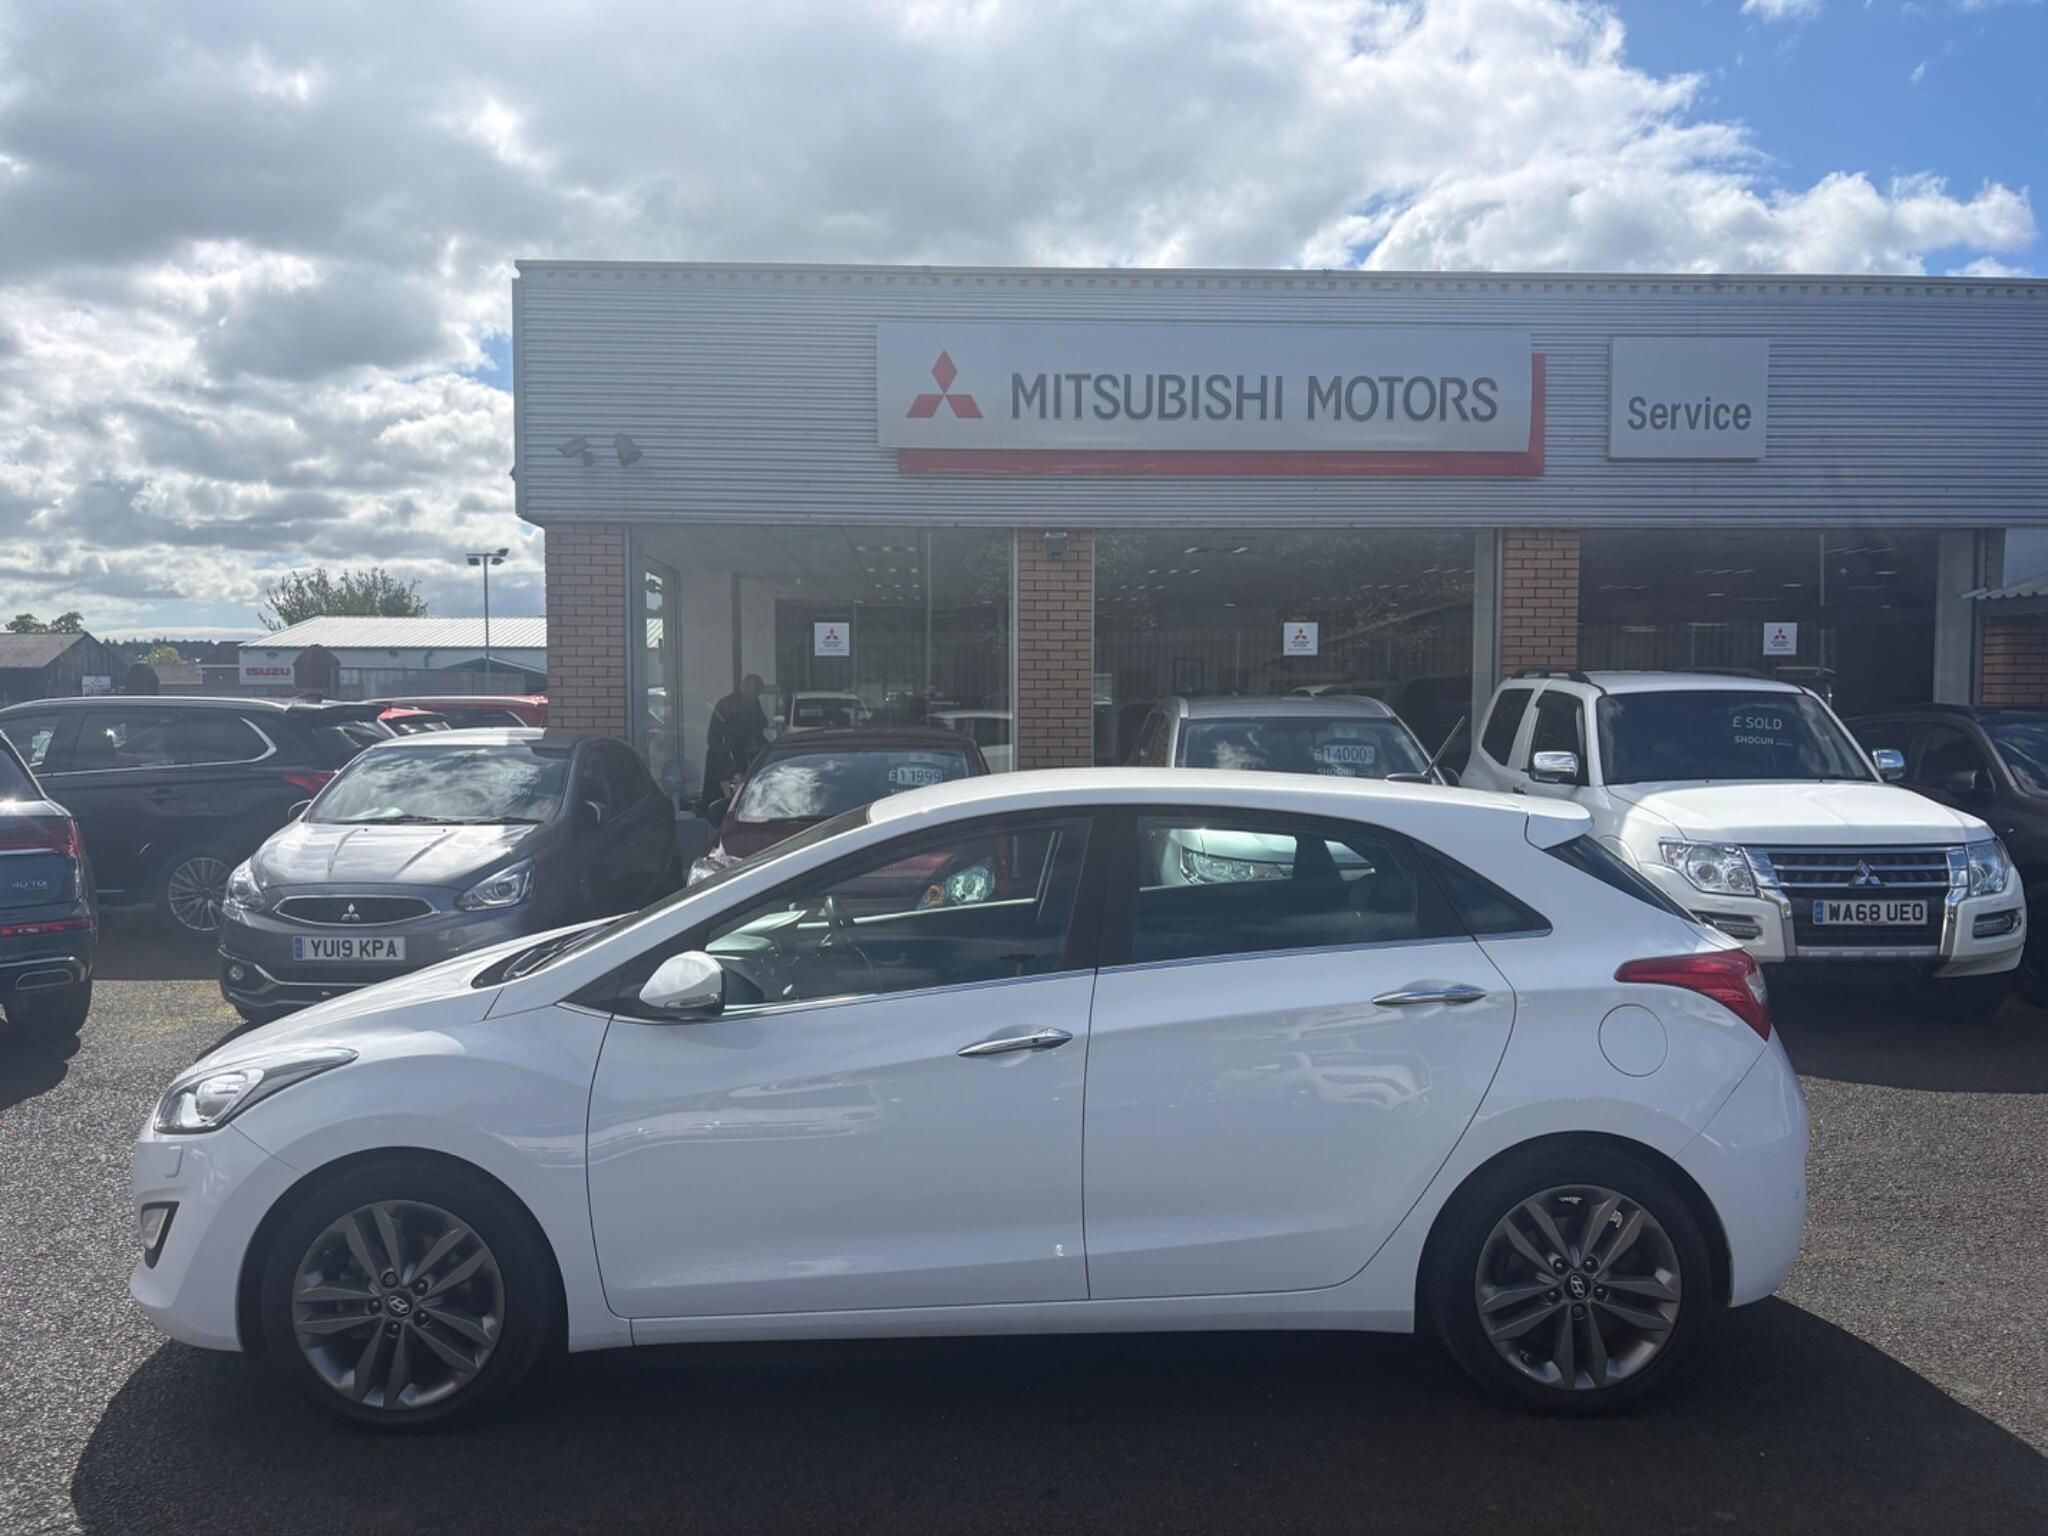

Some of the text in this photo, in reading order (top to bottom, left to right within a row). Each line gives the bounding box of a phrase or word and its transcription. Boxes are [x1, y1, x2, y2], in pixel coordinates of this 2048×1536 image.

[1011, 373, 1498, 422] MITSUBISHI MOTORS
[1627, 396, 1752, 431] Service
[245, 667, 290, 676] ISUZU
[1745, 716, 1782, 730] SOLD
[1734, 735, 1774, 745] SHOGUN
[1828, 903, 1924, 921] WA68 UEO
[310, 939, 398, 958] YU19 KPA
